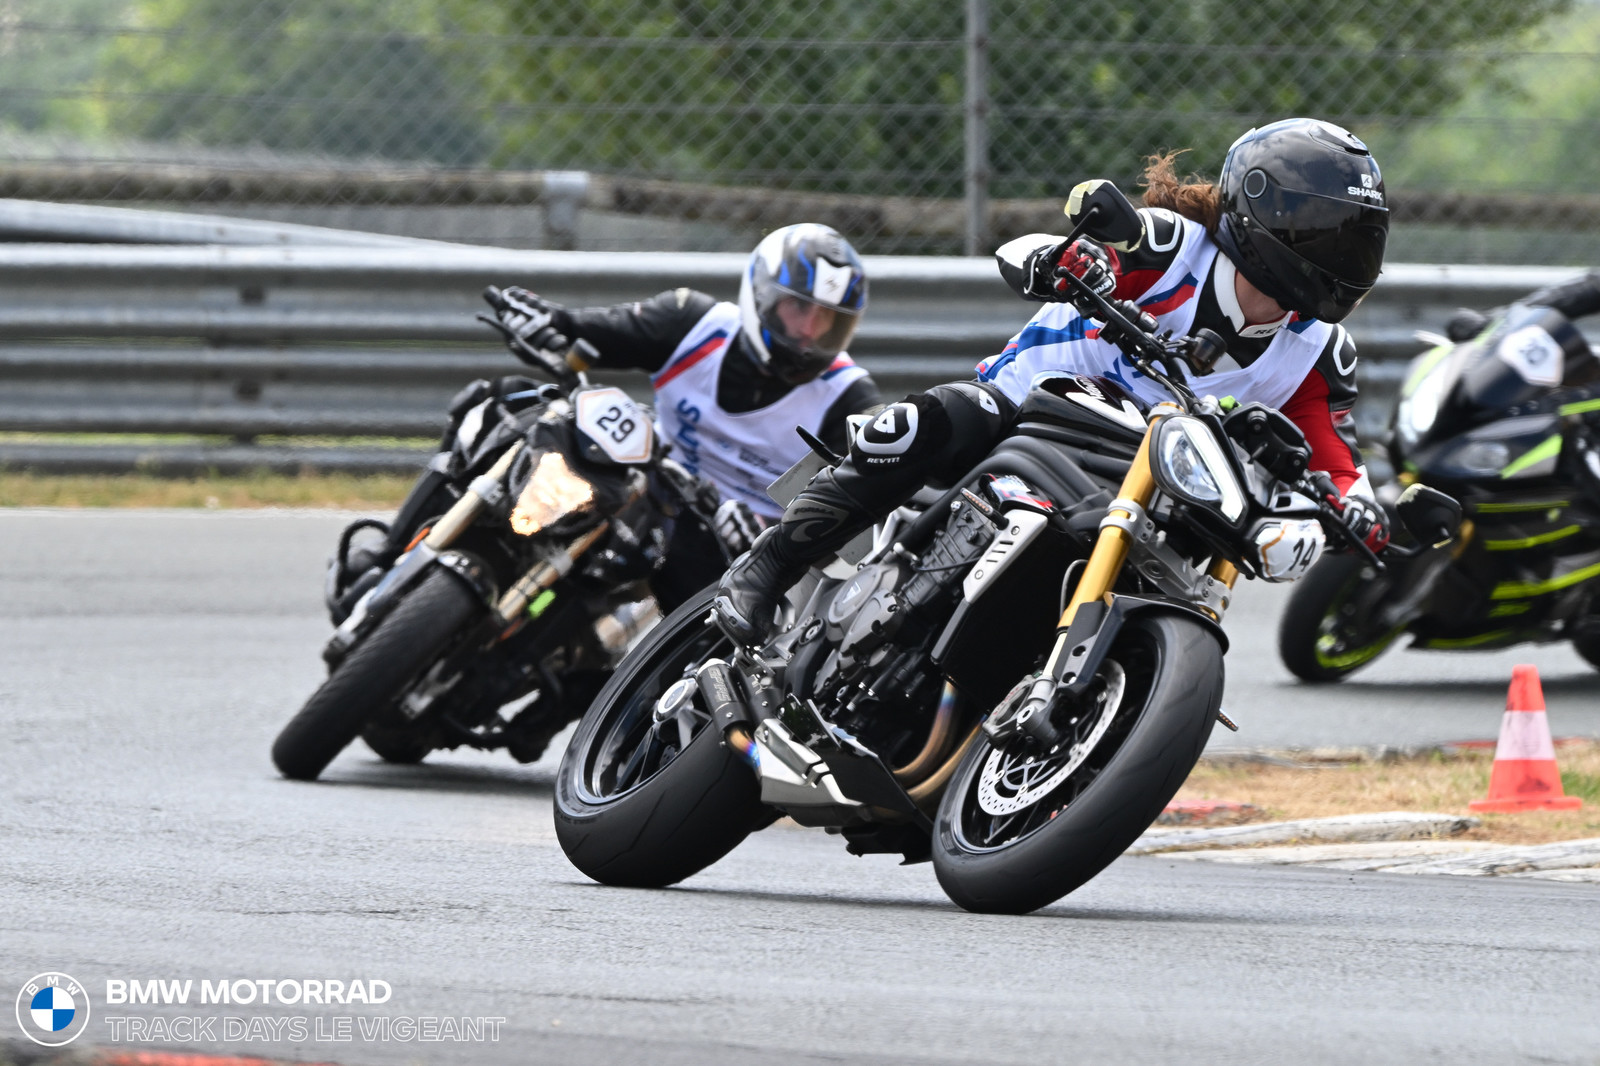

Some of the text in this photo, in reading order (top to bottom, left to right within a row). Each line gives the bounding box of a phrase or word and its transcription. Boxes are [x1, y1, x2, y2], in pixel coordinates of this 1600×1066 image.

[1347, 185, 1383, 201] SHARK
[596, 406, 636, 443] 29
[1288, 538, 1316, 572] 14
